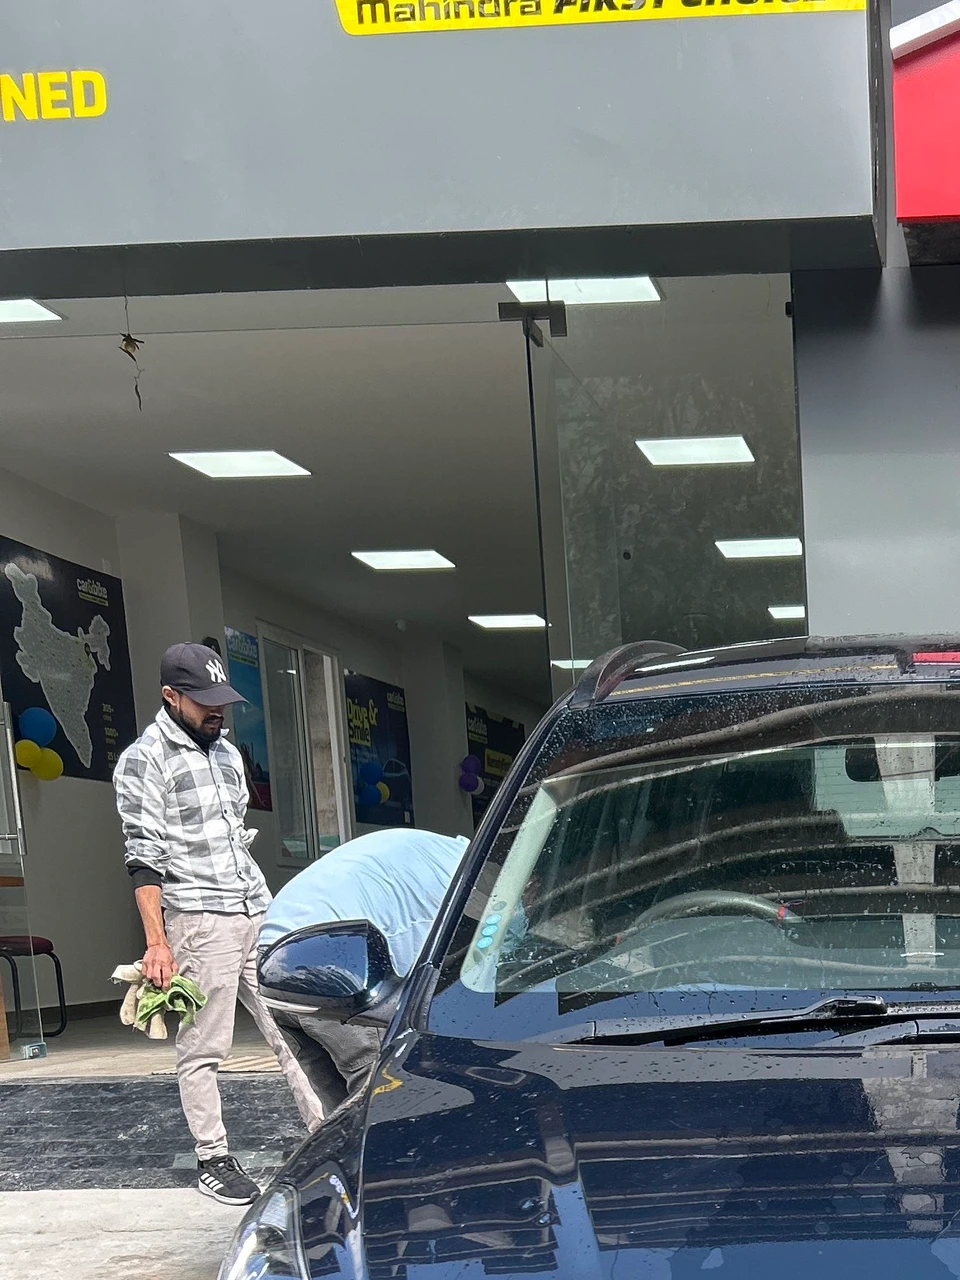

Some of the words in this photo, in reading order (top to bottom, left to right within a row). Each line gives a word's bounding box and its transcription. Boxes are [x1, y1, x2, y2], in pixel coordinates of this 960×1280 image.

[357, 0, 542, 25] Mahindra
[0, 70, 107, 122] NED
[347, 697, 368, 721] Drive
